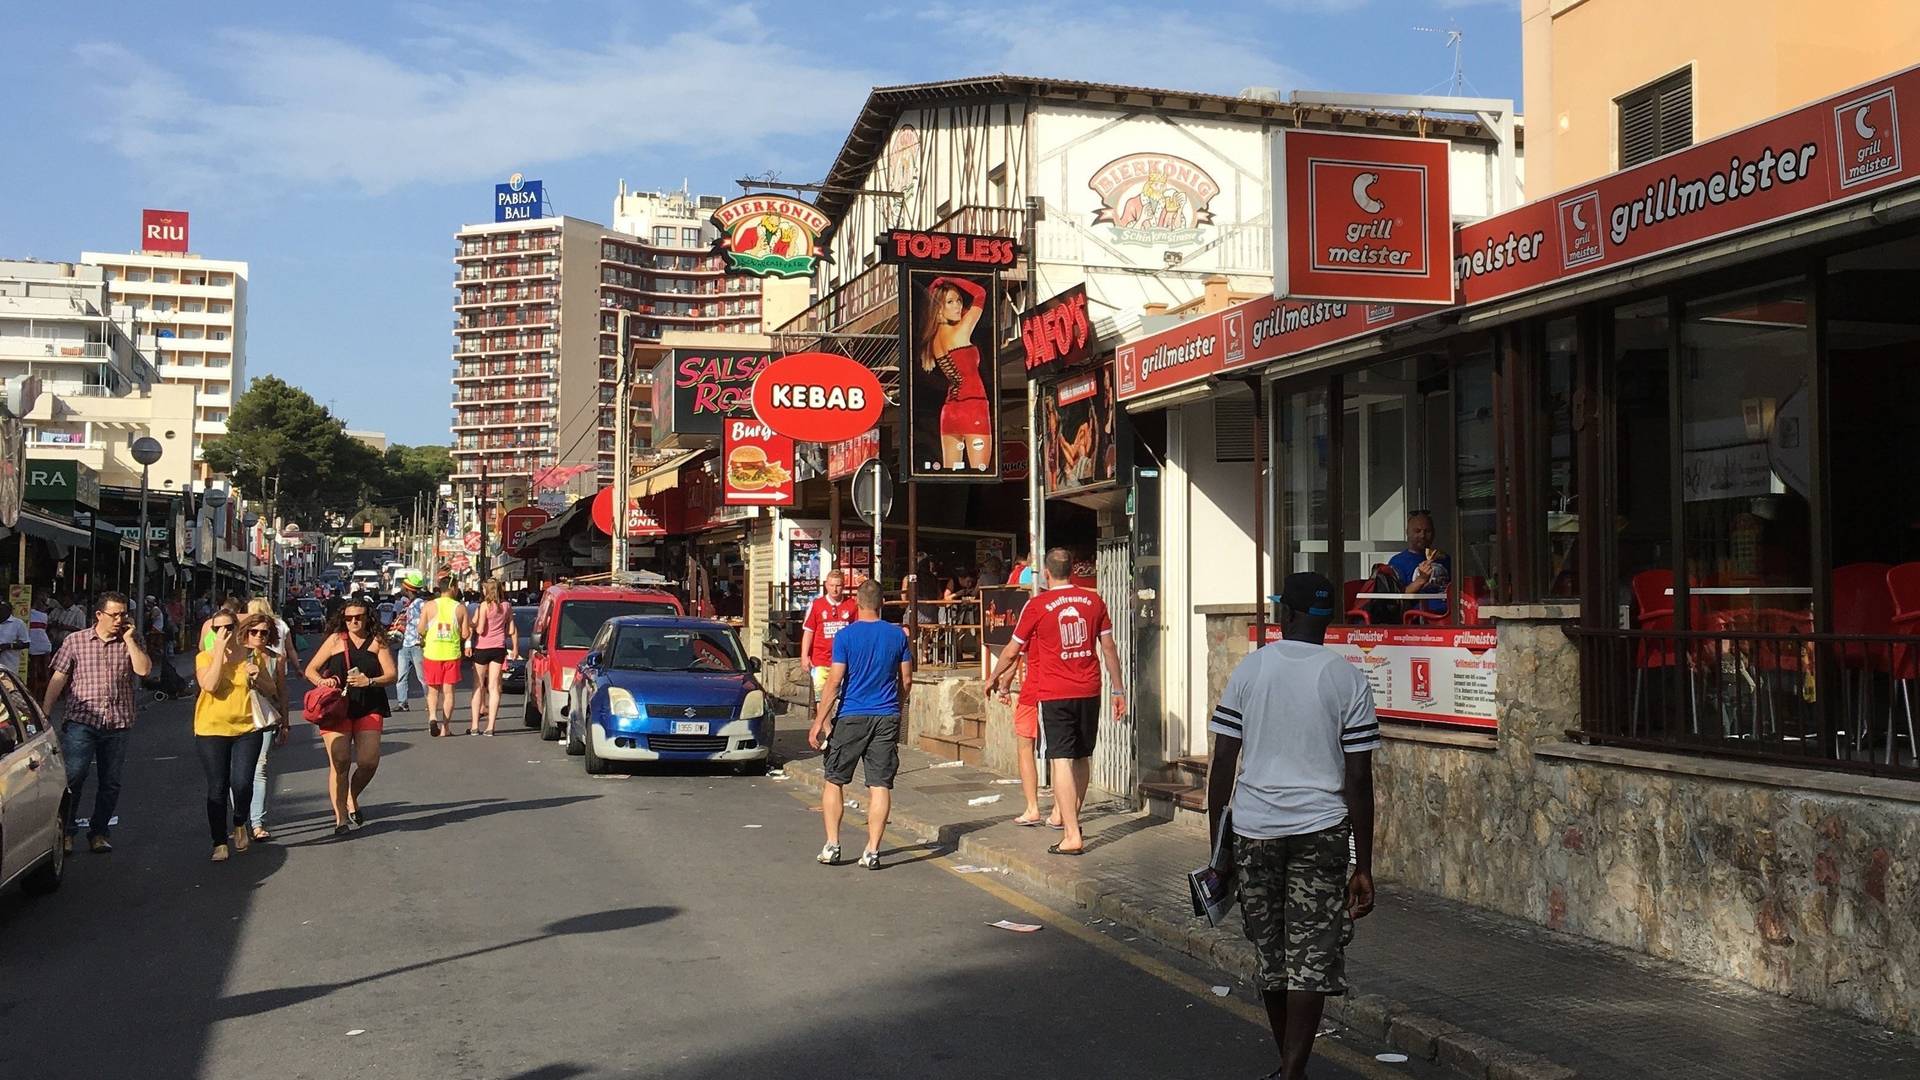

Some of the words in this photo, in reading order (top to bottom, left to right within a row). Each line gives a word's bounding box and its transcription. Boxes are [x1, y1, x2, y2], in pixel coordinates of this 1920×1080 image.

[1857, 138, 1882, 163] grill
[1849, 154, 1893, 178] meister
[498, 191, 537, 206] PABISA
[1610, 143, 1817, 245] grillmeister
[505, 206, 530, 220] BALI
[721, 199, 823, 229] BIERKÖNIG
[147, 224, 184, 241] RIU
[1346, 218, 1393, 243] grill
[1574, 232, 1591, 250] grill
[892, 231, 952, 259] TOP
[957, 237, 1014, 265] LESS
[1328, 244, 1412, 265] meister
[1569, 244, 1598, 261] meister
[1252, 302, 1347, 349] grillmeister
[1141, 335, 1216, 381] grillmeister
[772, 384, 865, 409] KEBAB
[25, 471, 67, 487] RA
[1347, 629, 1384, 644] grillmeister
